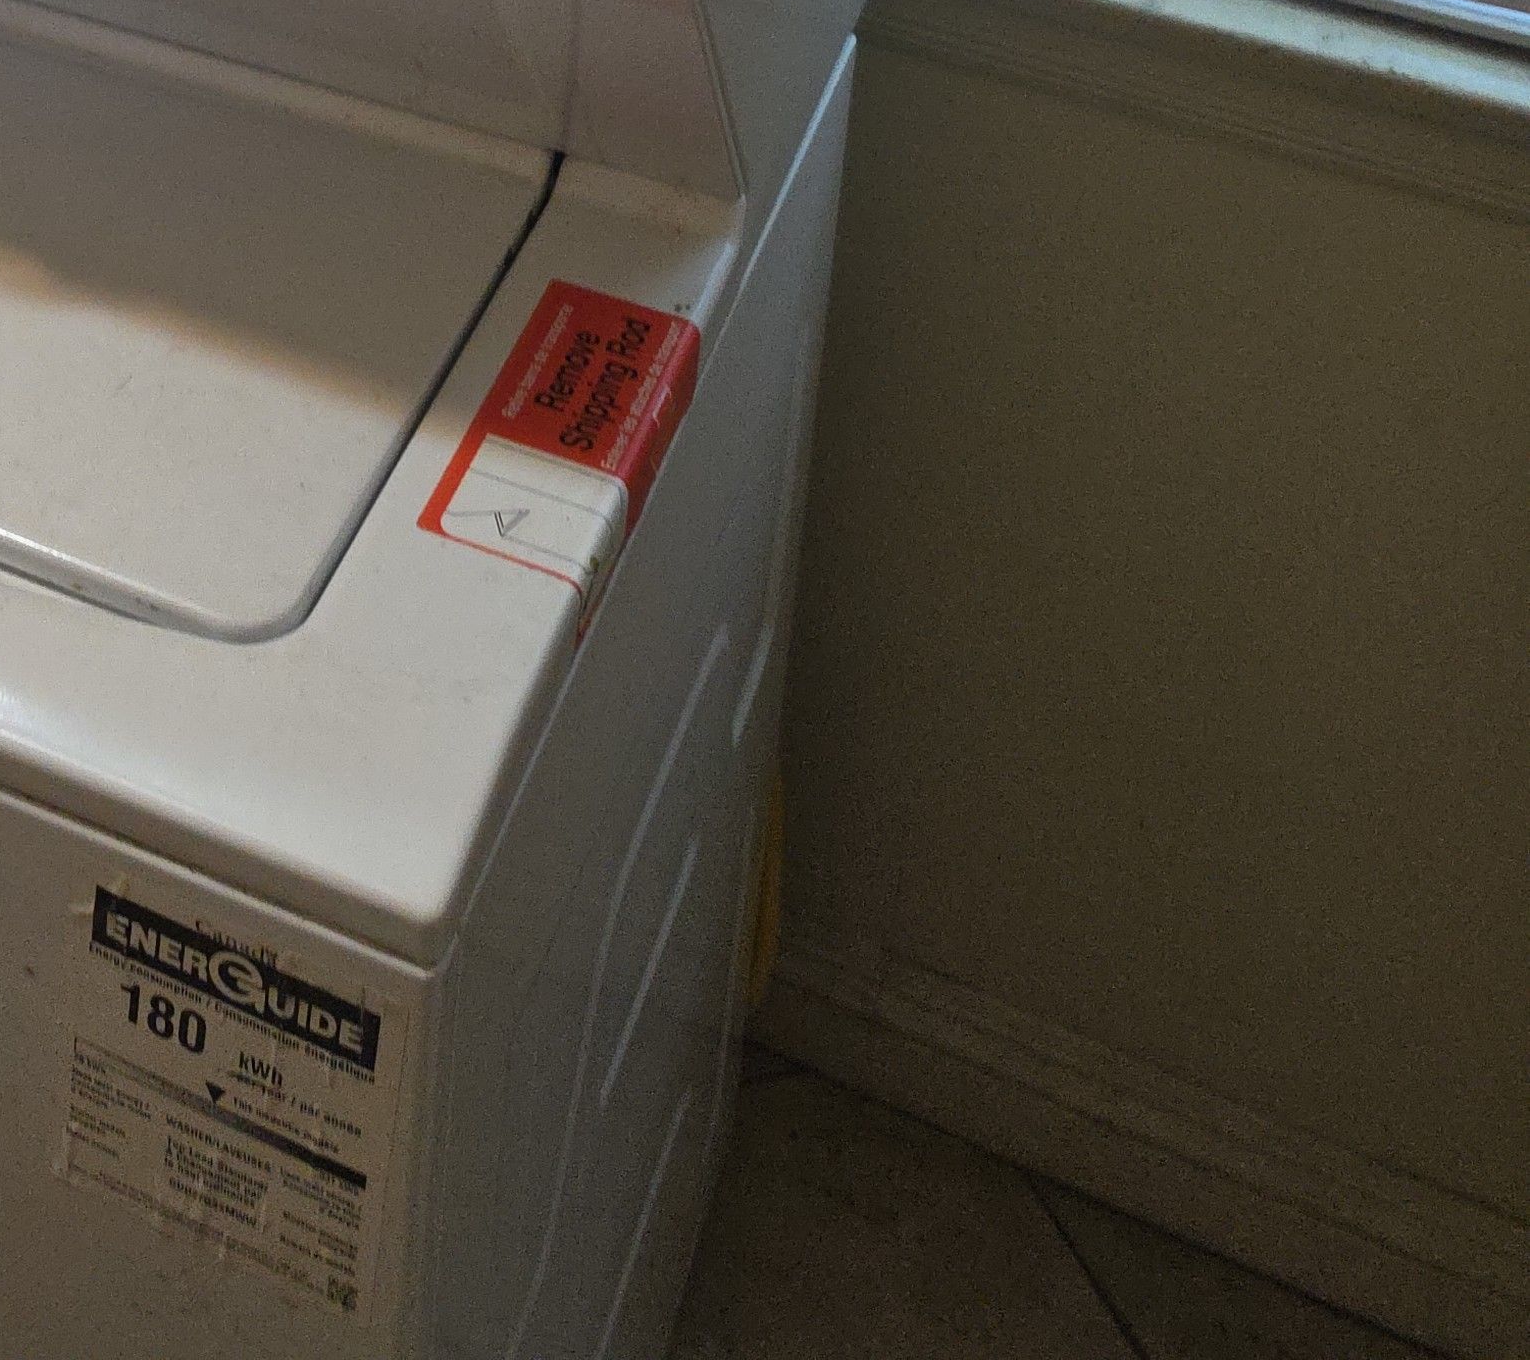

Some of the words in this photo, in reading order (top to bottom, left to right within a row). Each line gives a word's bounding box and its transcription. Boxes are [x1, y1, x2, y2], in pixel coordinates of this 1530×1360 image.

[534, 329, 601, 412] Remove
[558, 356, 639, 454] Shipping
[604, 315, 652, 361] Rod
[120, 981, 208, 1056] 180
[238, 1051, 284, 1088] kWh
